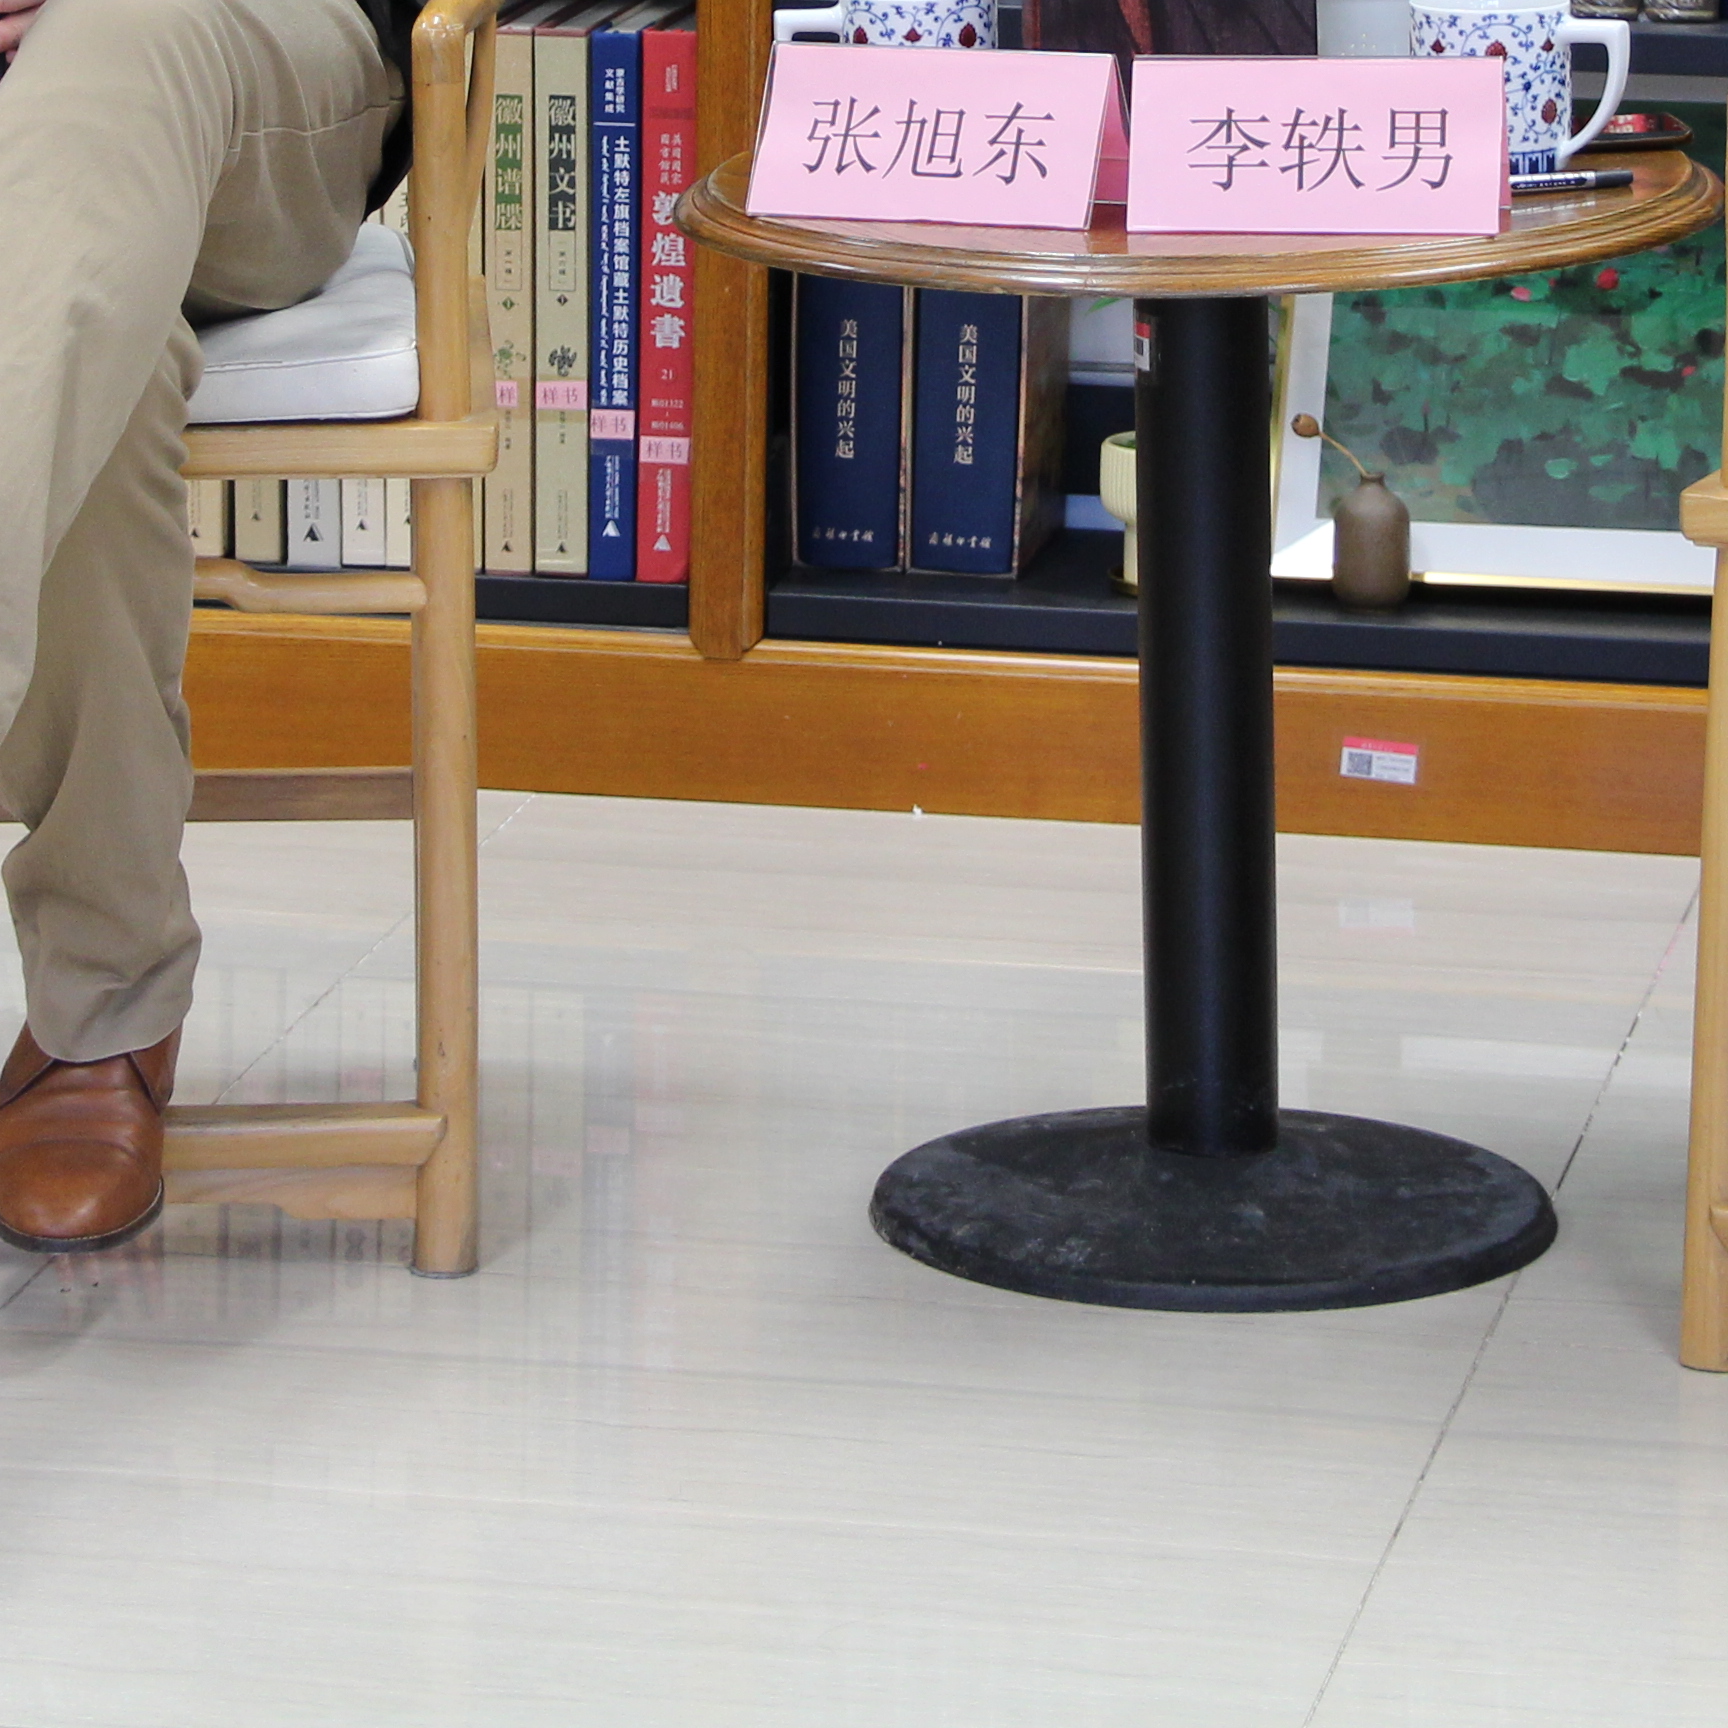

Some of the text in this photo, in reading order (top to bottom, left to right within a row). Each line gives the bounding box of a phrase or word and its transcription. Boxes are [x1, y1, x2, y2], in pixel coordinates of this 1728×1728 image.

[495, 97, 523, 231] 徽州谱牒
[548, 97, 577, 230] 徽州文书
[801, 98, 1058, 184] 张旭东
[1186, 105, 1456, 195] 李轶男
[650, 190, 687, 349] 敦煌遺書
[498, 385, 515, 404] 样
[646, 440, 682, 458] 样书
[834, 318, 858, 459] 美国文明的兴起
[953, 323, 979, 466] 美国文明的兴起
